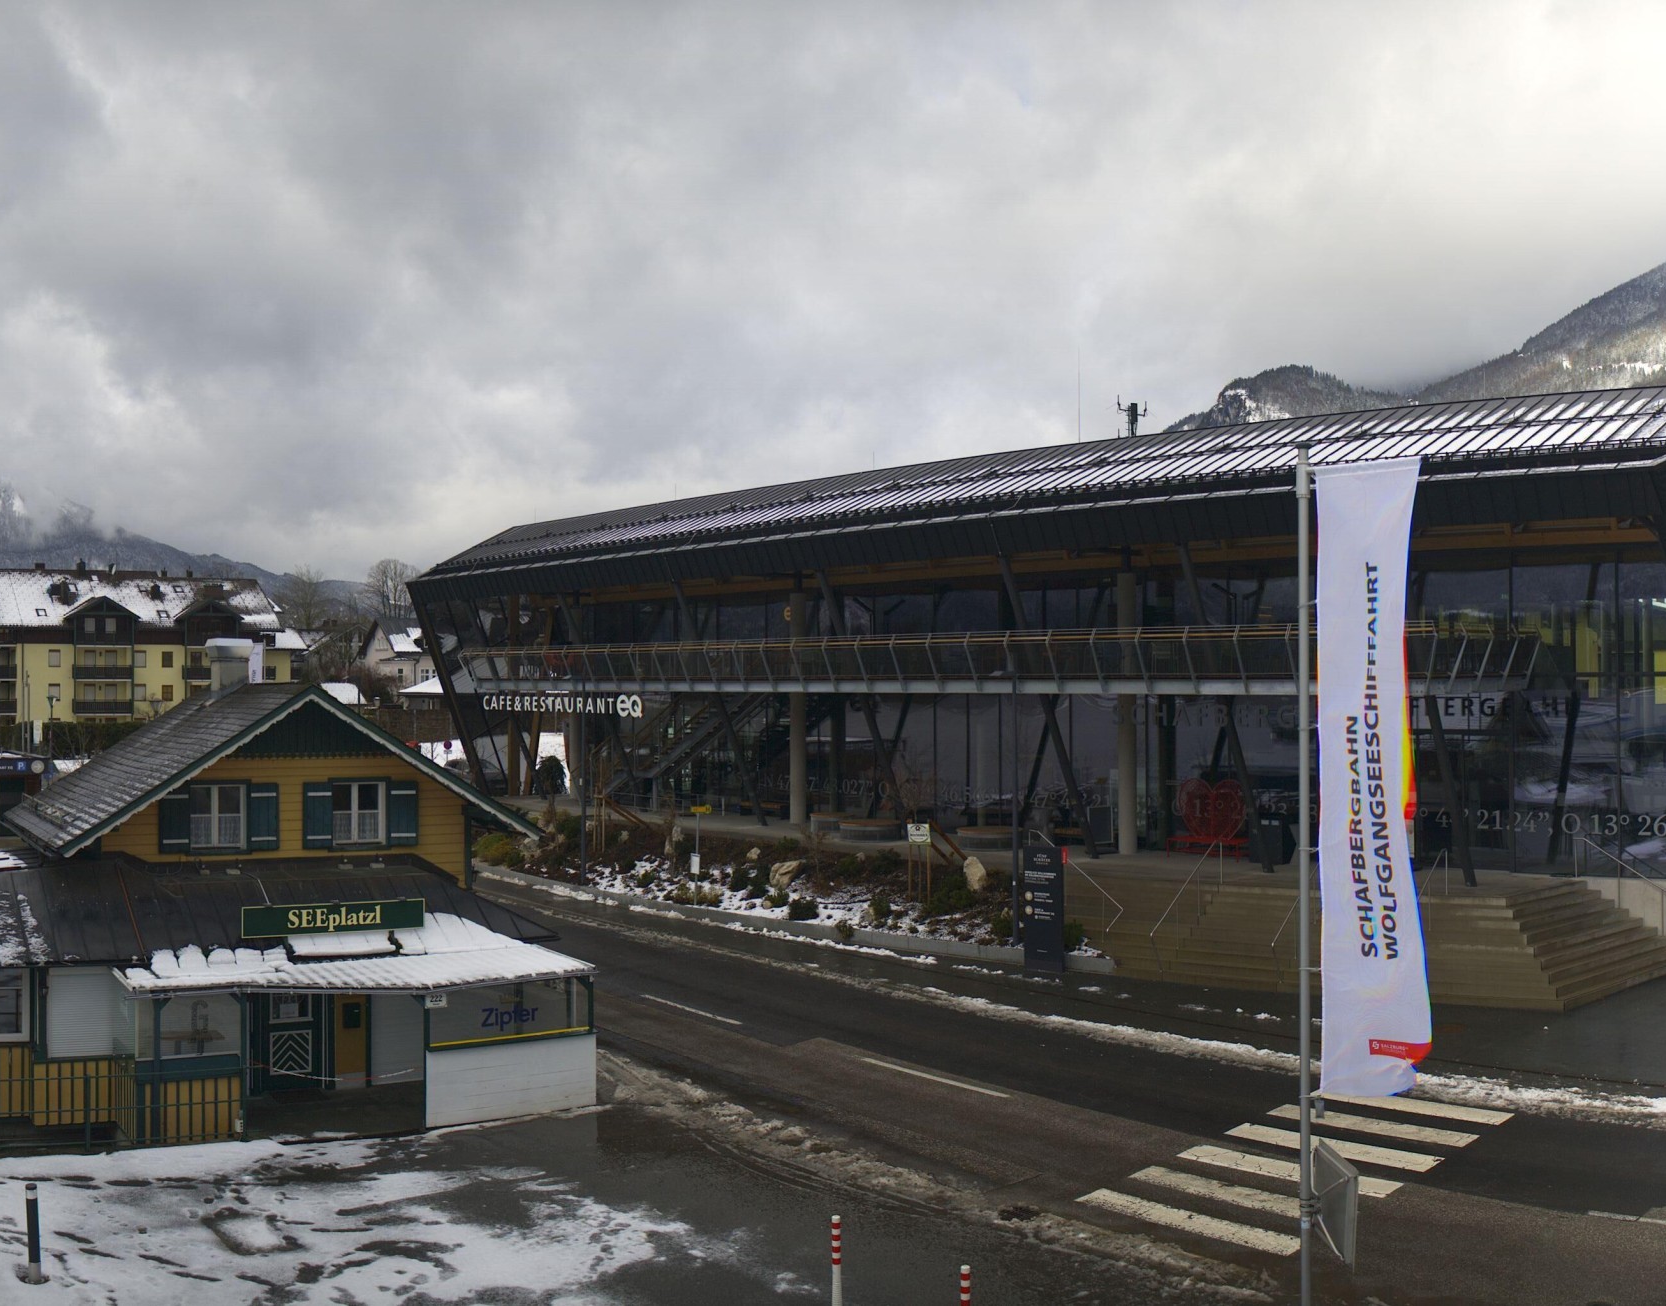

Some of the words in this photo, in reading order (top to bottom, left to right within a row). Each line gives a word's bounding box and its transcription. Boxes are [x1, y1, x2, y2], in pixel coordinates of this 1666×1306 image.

[1364, 561, 1399, 961] WOLFGANGSEESCHIFFFAHRT
[1346, 715, 1378, 958] SCHAFBERGBAHN
[1590, 813, 1631, 836] 13°
[287, 904, 381, 932] SEEplatzl
[429, 994, 443, 1003] 222
[481, 1004, 539, 1032] Zipfer
